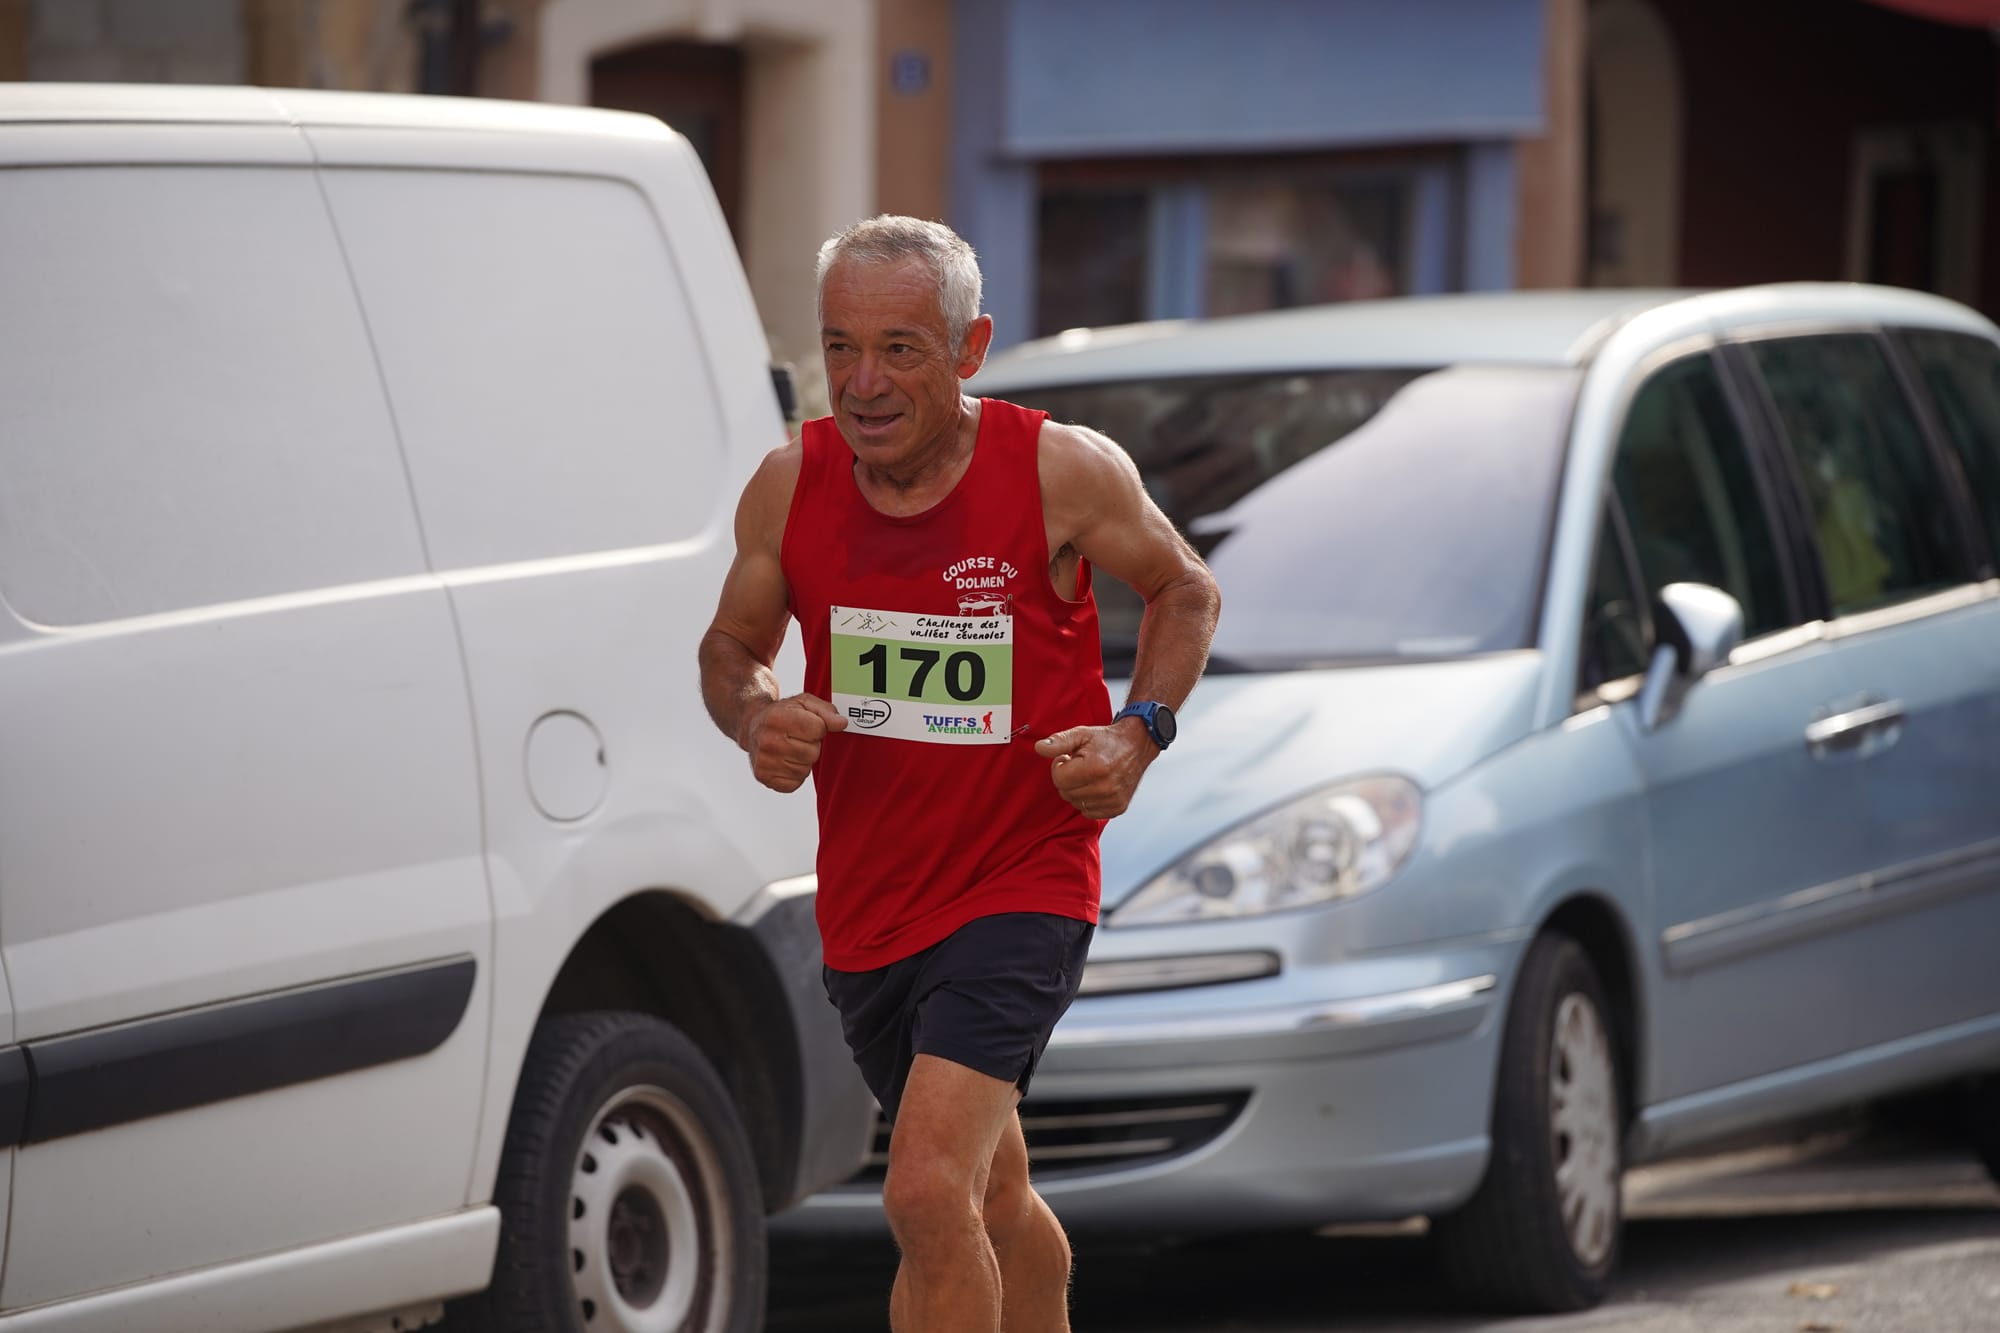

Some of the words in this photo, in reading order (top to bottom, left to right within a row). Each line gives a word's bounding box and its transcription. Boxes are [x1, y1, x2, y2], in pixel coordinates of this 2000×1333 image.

[943, 556, 995, 582] COURSE
[999, 561, 1018, 579] DU
[955, 575, 1005, 590] DOLMEN
[916, 617, 973, 632] Challenge
[980, 620, 999, 629] des
[910, 629, 949, 639] vallées
[956, 630, 1005, 640] cévenoles
[859, 643, 986, 702] 170
[848, 706, 885, 719] BFP
[923, 714, 977, 728] TUFF'S
[928, 724, 983, 735] Aventure
